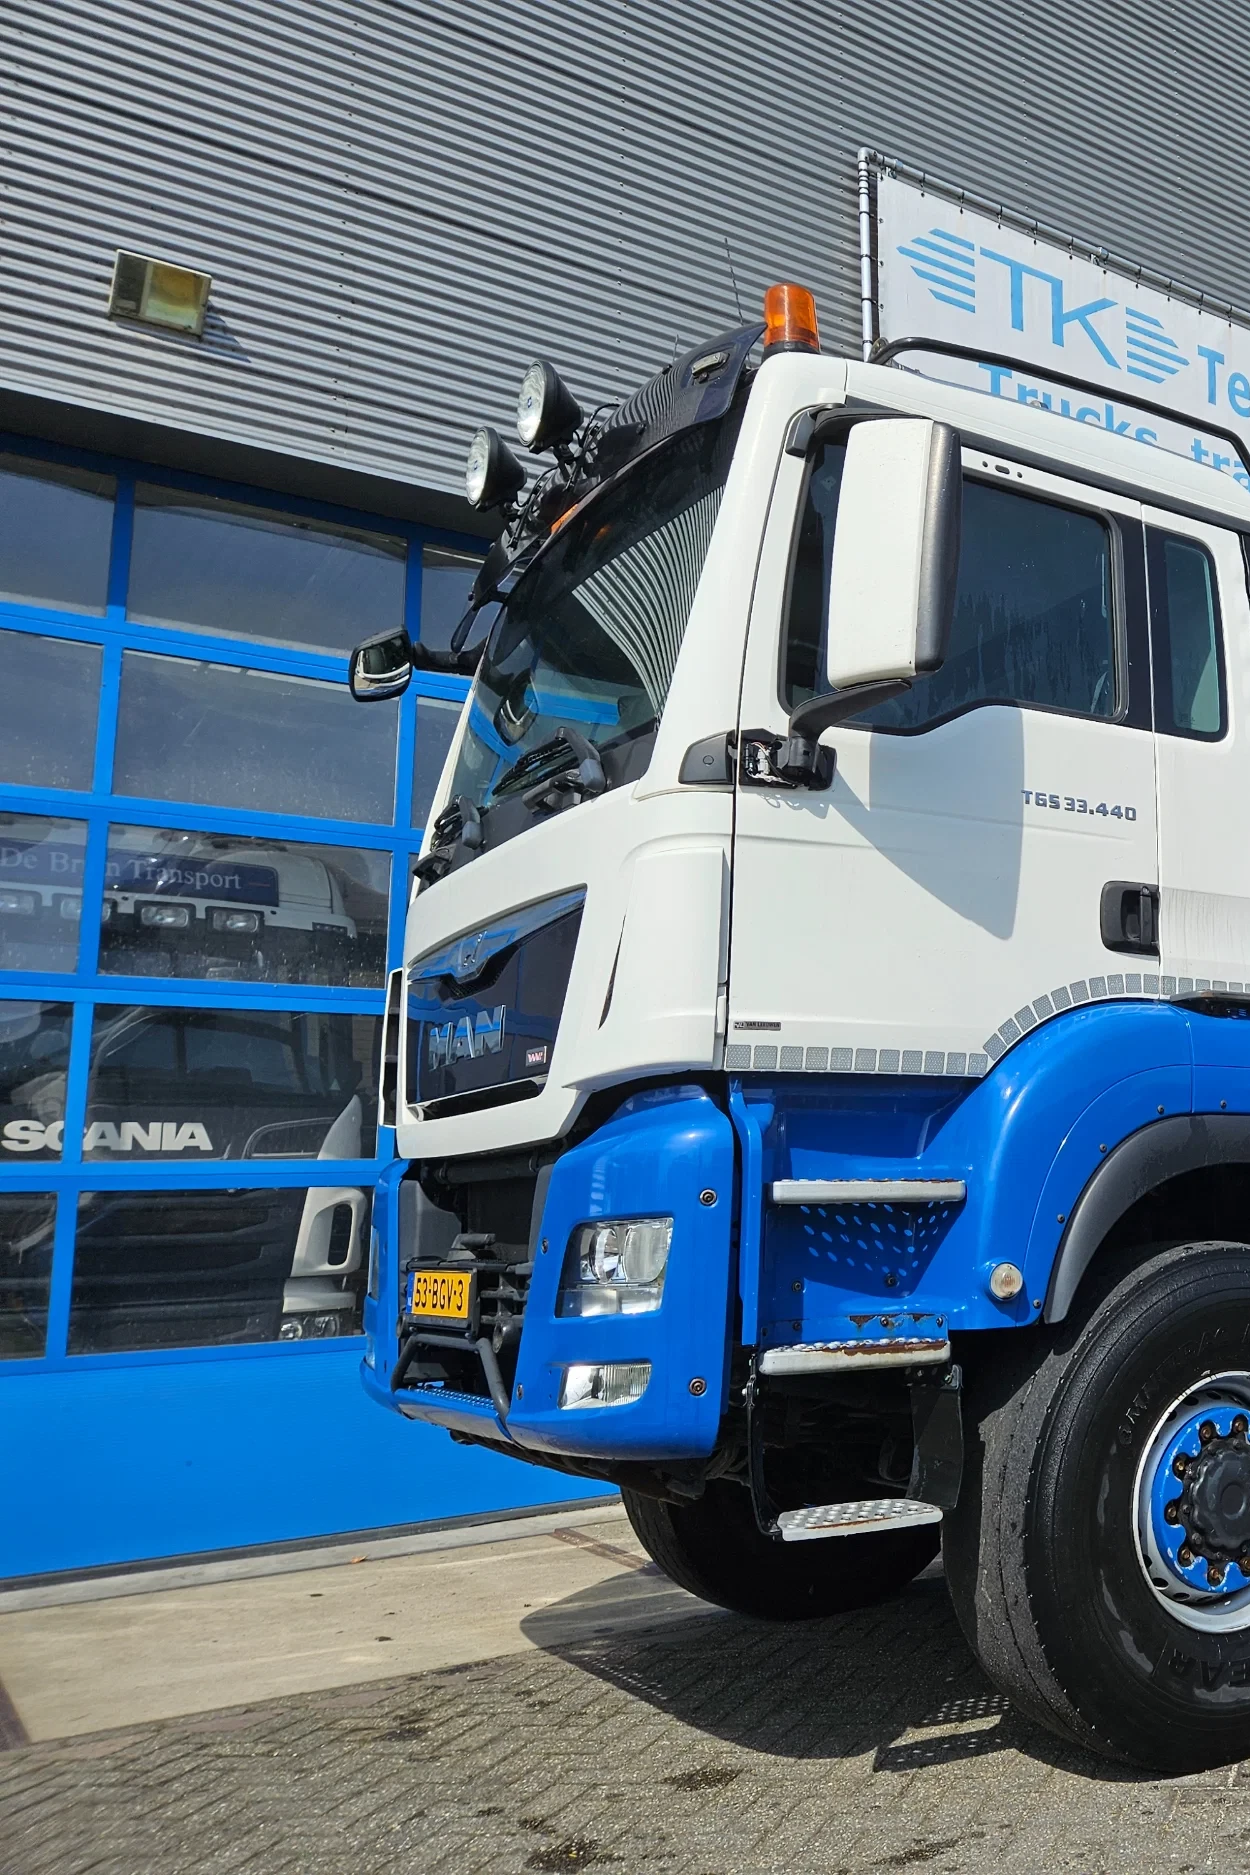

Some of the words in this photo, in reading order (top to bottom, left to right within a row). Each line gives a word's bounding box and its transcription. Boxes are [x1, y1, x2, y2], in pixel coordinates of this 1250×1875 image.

[980, 246, 1121, 371] TK
[1021, 789, 1061, 810] TGS
[1064, 796, 1137, 822] 33.440
[0, 846, 38, 870] De
[49, 851, 121, 877] Brn
[128, 858, 242, 890] Transport
[428, 1004, 507, 1072] MAN
[414, 1277, 464, 1311] 53-BGV-3
